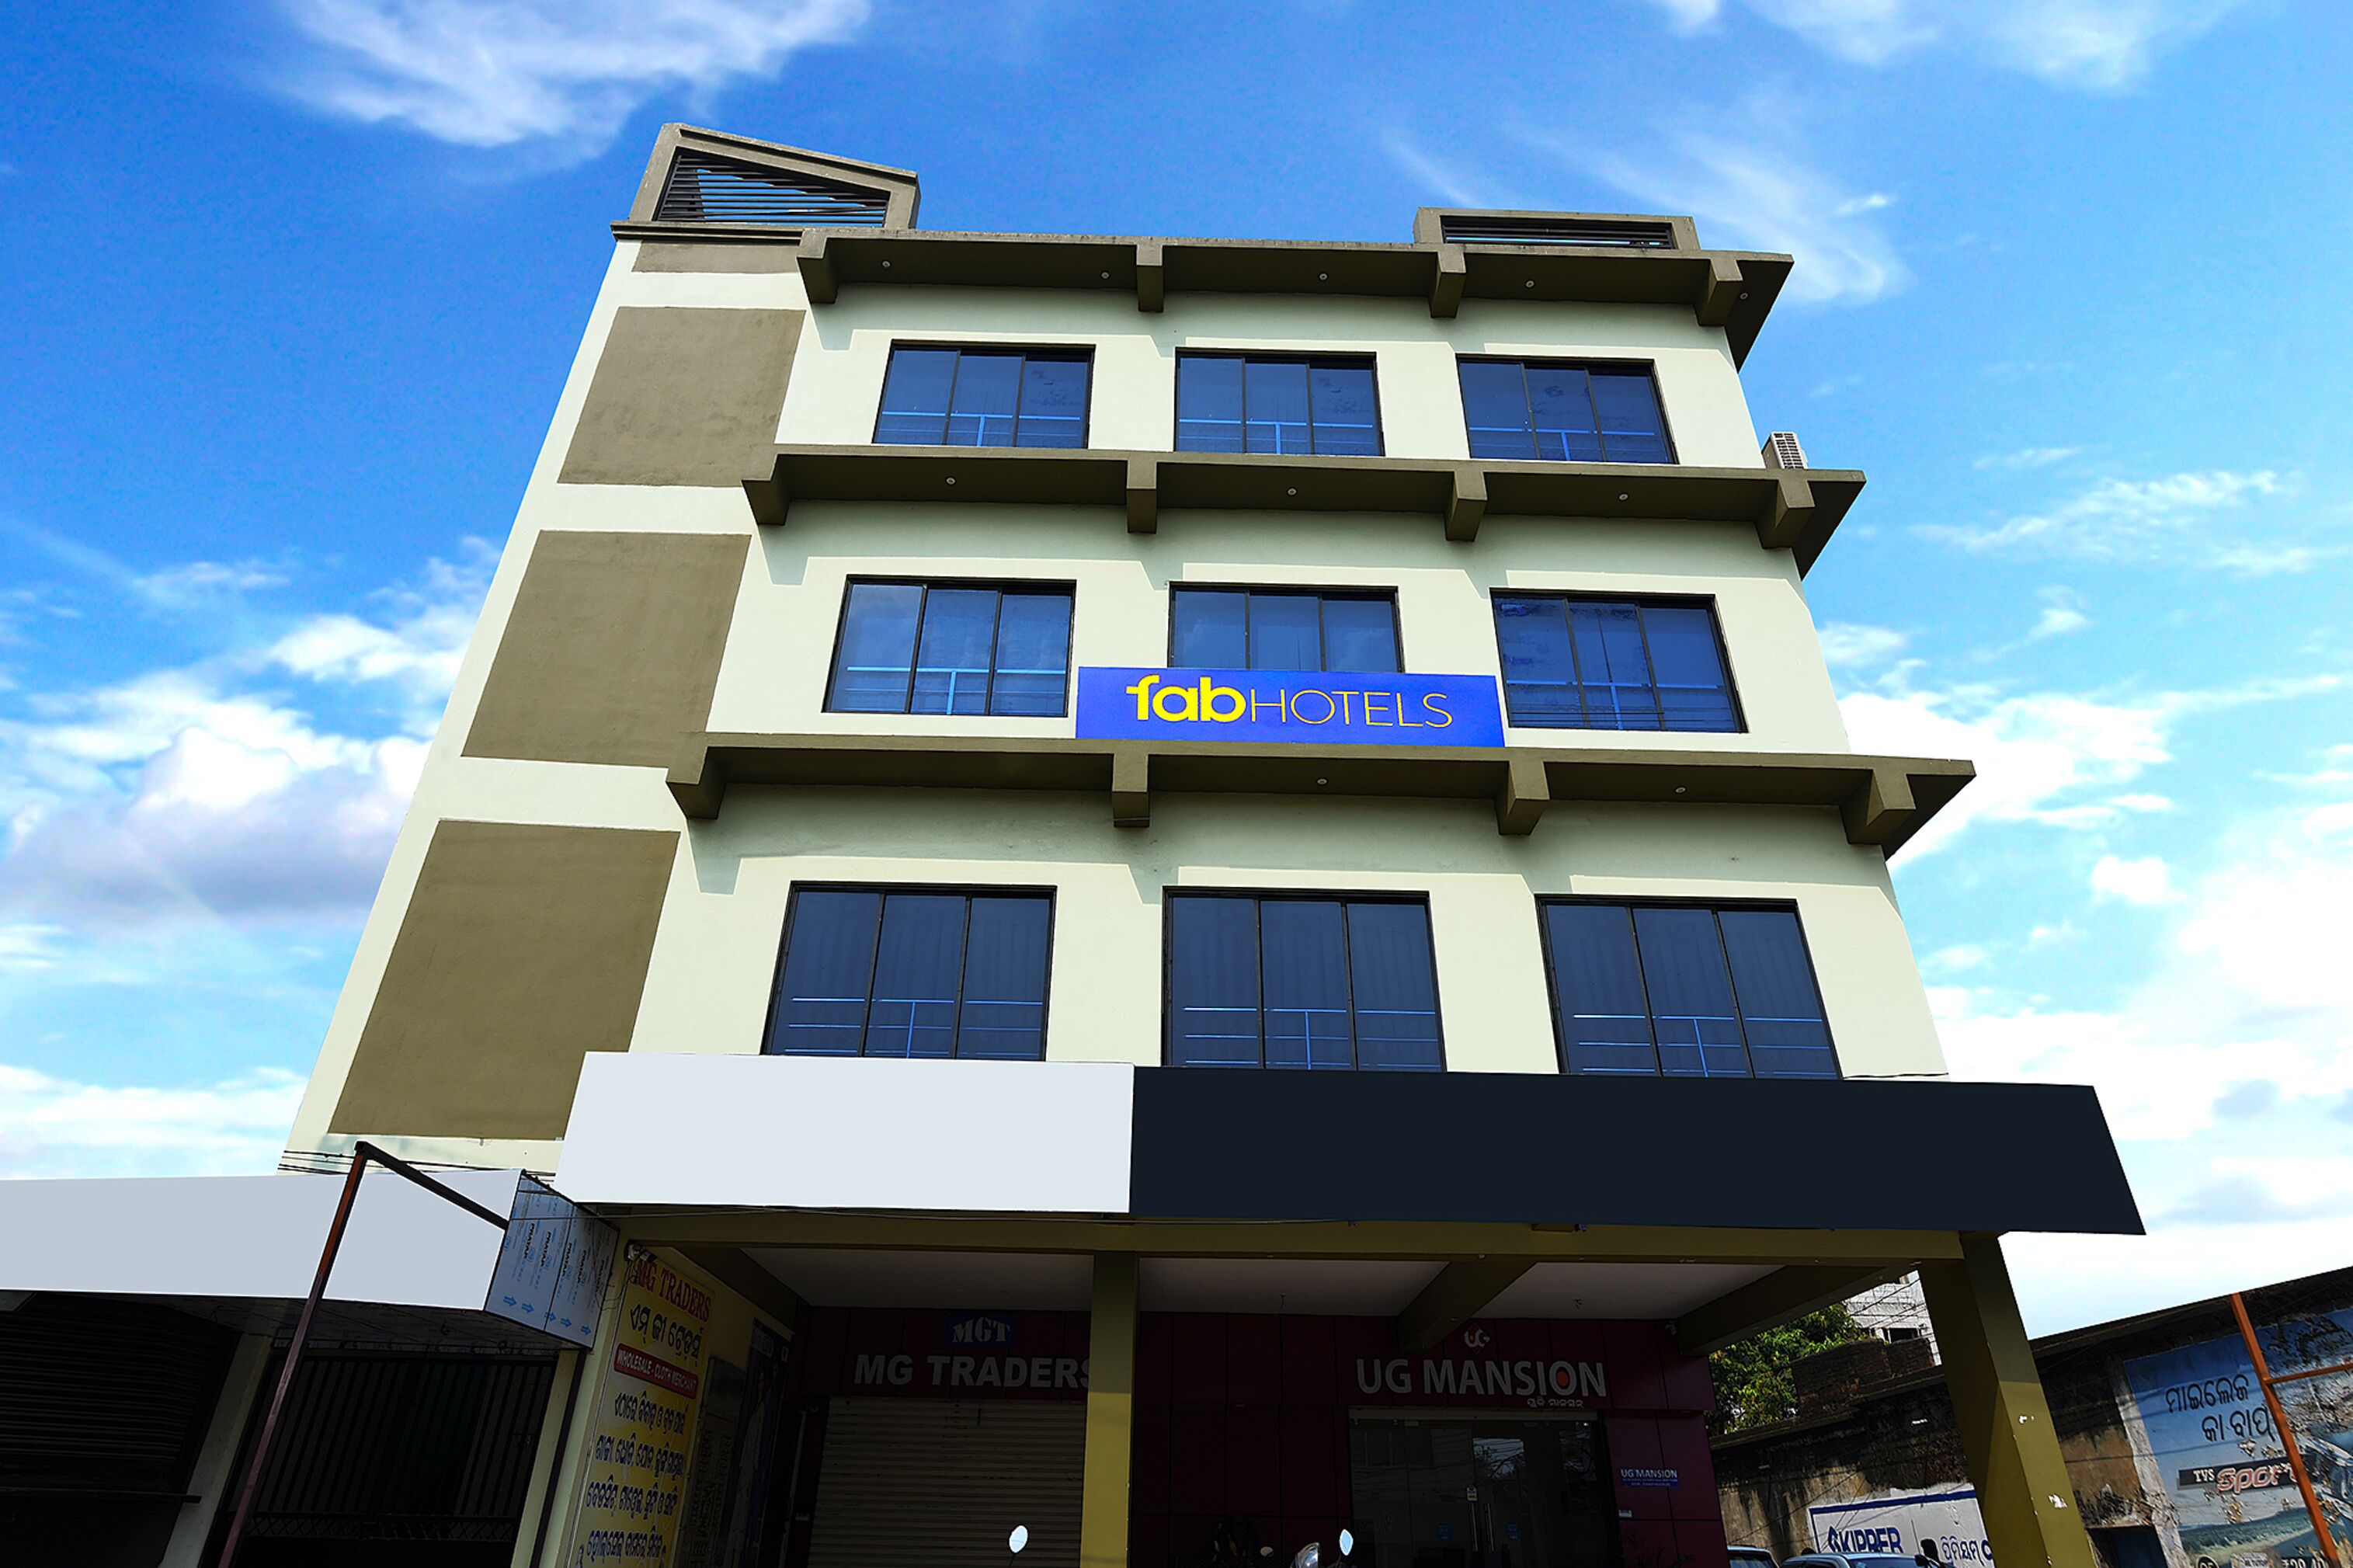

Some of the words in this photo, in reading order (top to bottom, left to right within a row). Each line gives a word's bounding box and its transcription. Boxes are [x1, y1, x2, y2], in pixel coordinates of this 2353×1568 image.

[659, 1267, 712, 1323] TRADERS
[952, 1316, 1011, 1344] MGT
[617, 1347, 653, 1375] WHOLESALE
[854, 1354, 914, 1386] MG
[1356, 1357, 1413, 1395] UG
[1423, 1359, 1607, 1398] MANSION
[1620, 1469, 1634, 1478] UG
[1635, 1469, 1678, 1479] MANSION
[2193, 1469, 2215, 1483] TVS
